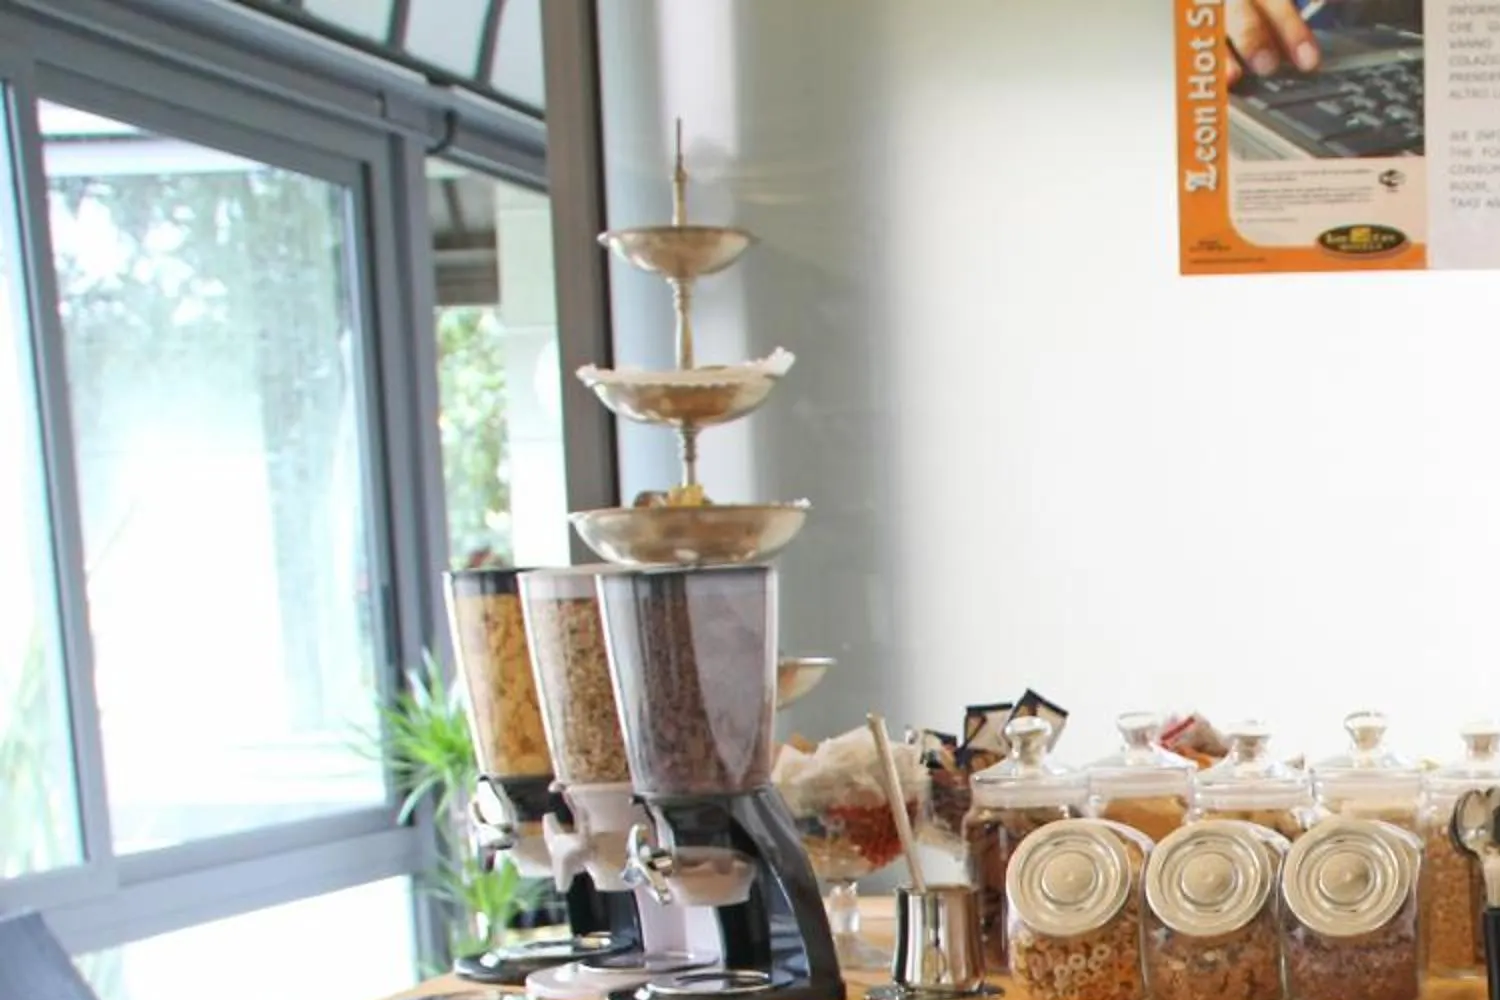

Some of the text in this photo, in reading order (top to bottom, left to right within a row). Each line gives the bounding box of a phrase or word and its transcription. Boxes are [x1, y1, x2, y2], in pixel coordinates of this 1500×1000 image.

[1448, 21, 1472, 33] CHE
[1449, 37, 1492, 49] VANNO
[1184, 0, 1222, 192] Leon Hot S
[1449, 130, 1468, 141] WE
[1449, 146, 1473, 158] THE
[1450, 197, 1481, 208] TAKE
